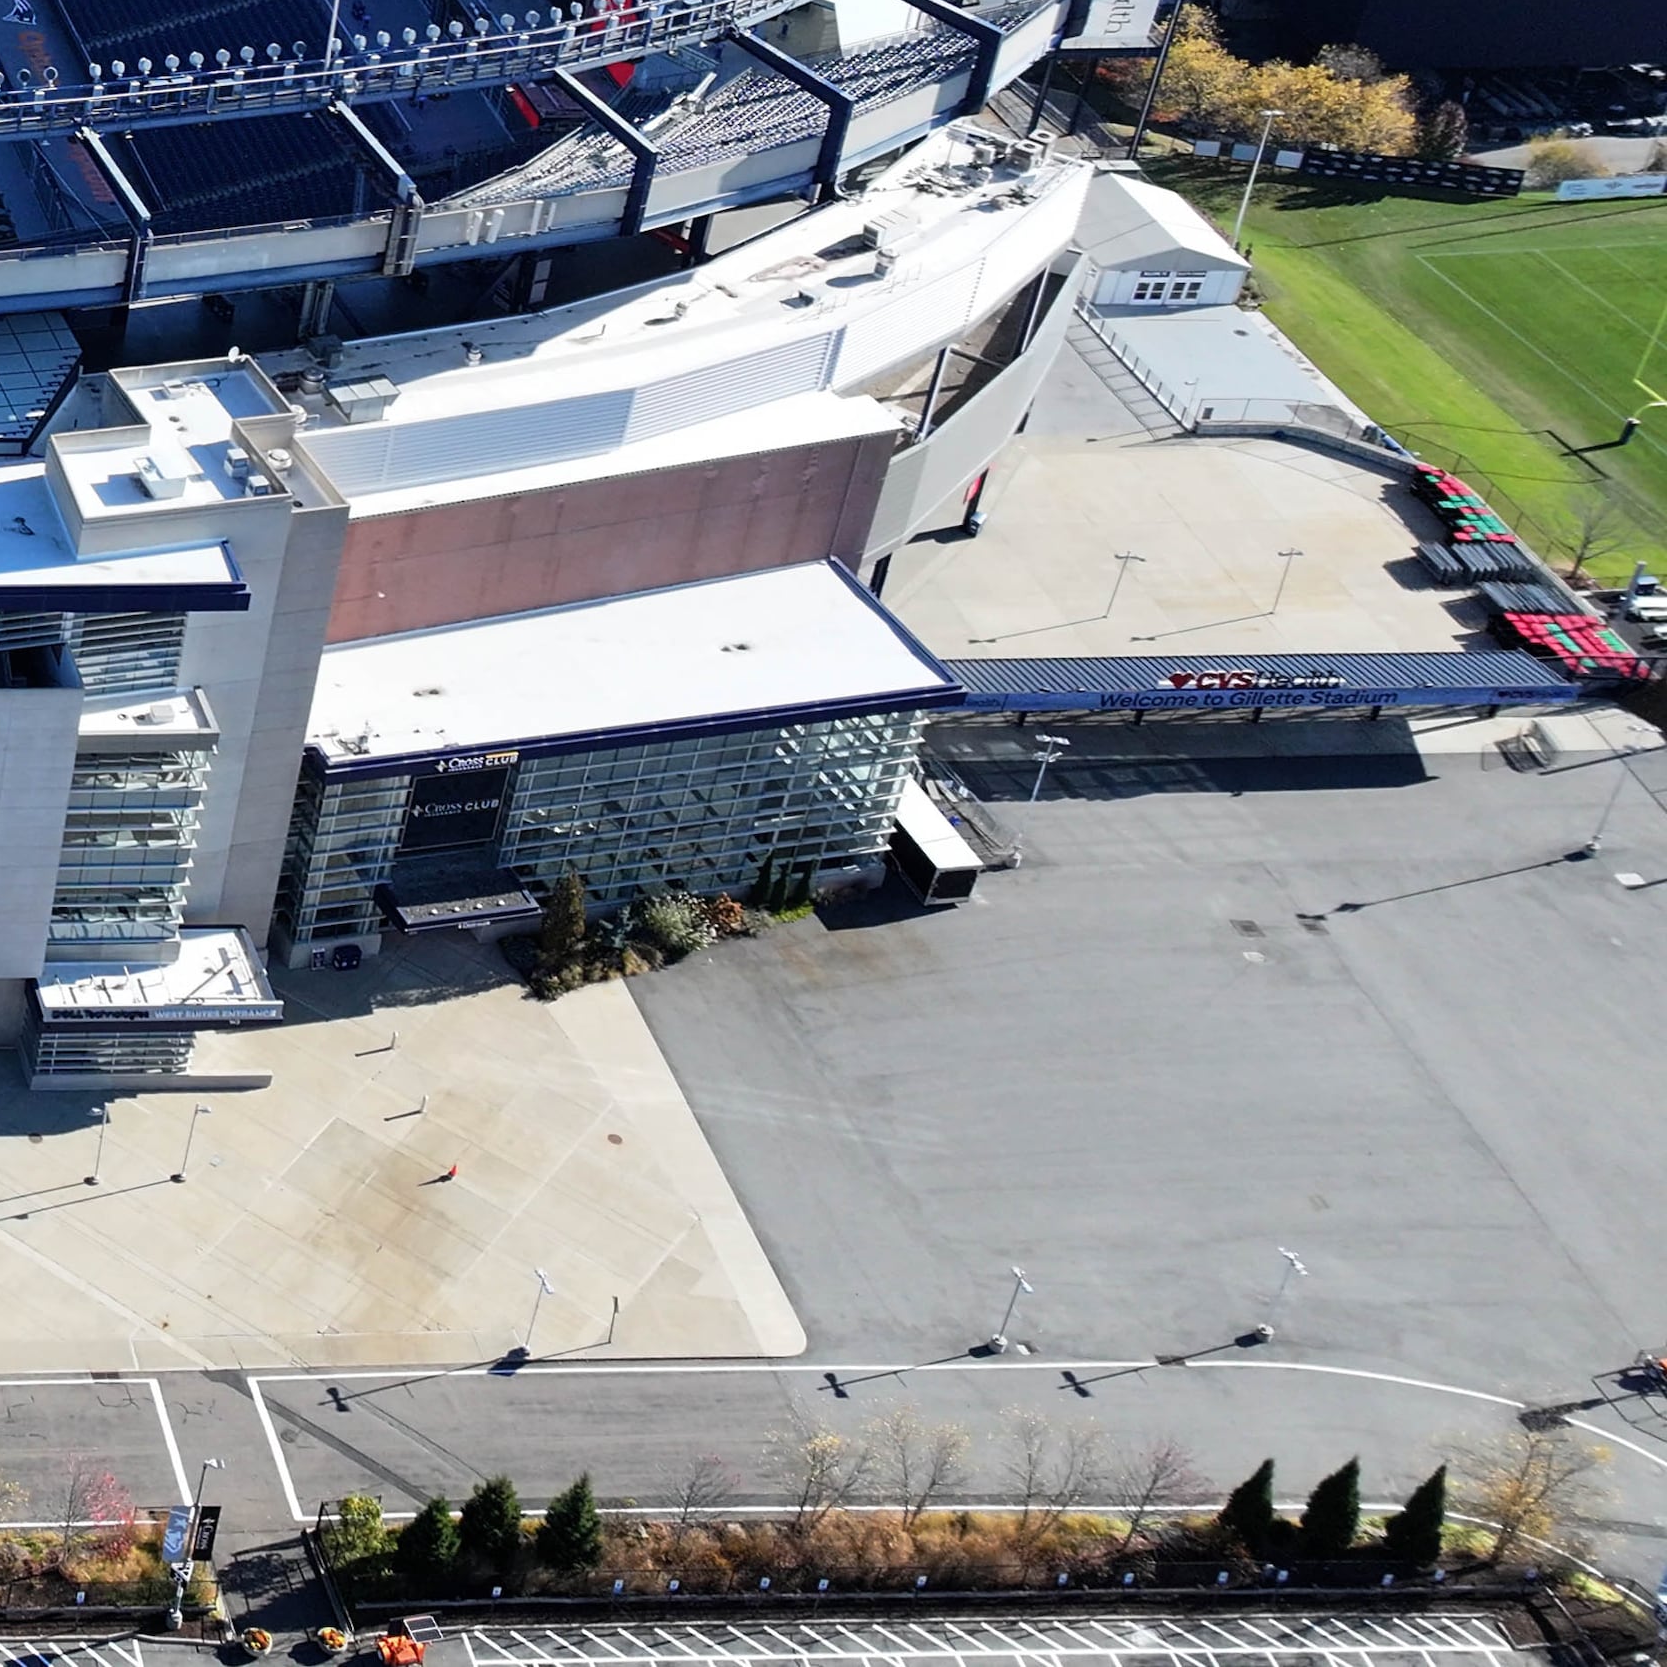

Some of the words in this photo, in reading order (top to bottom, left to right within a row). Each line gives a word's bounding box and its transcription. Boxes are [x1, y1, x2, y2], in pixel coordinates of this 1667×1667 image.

[1099, 693, 1202, 709] Welcome
[1204, 693, 1224, 707] to
[1229, 690, 1304, 707] Gillette
[1309, 689, 1399, 705] Stadium
[485, 754, 518, 767] CLUB
[464, 799, 500, 812] CLUB
[154, 1009, 185, 1019] WEST
[186, 1009, 220, 1019] SUITES
[222, 1009, 276, 1018] ENTRANCE
